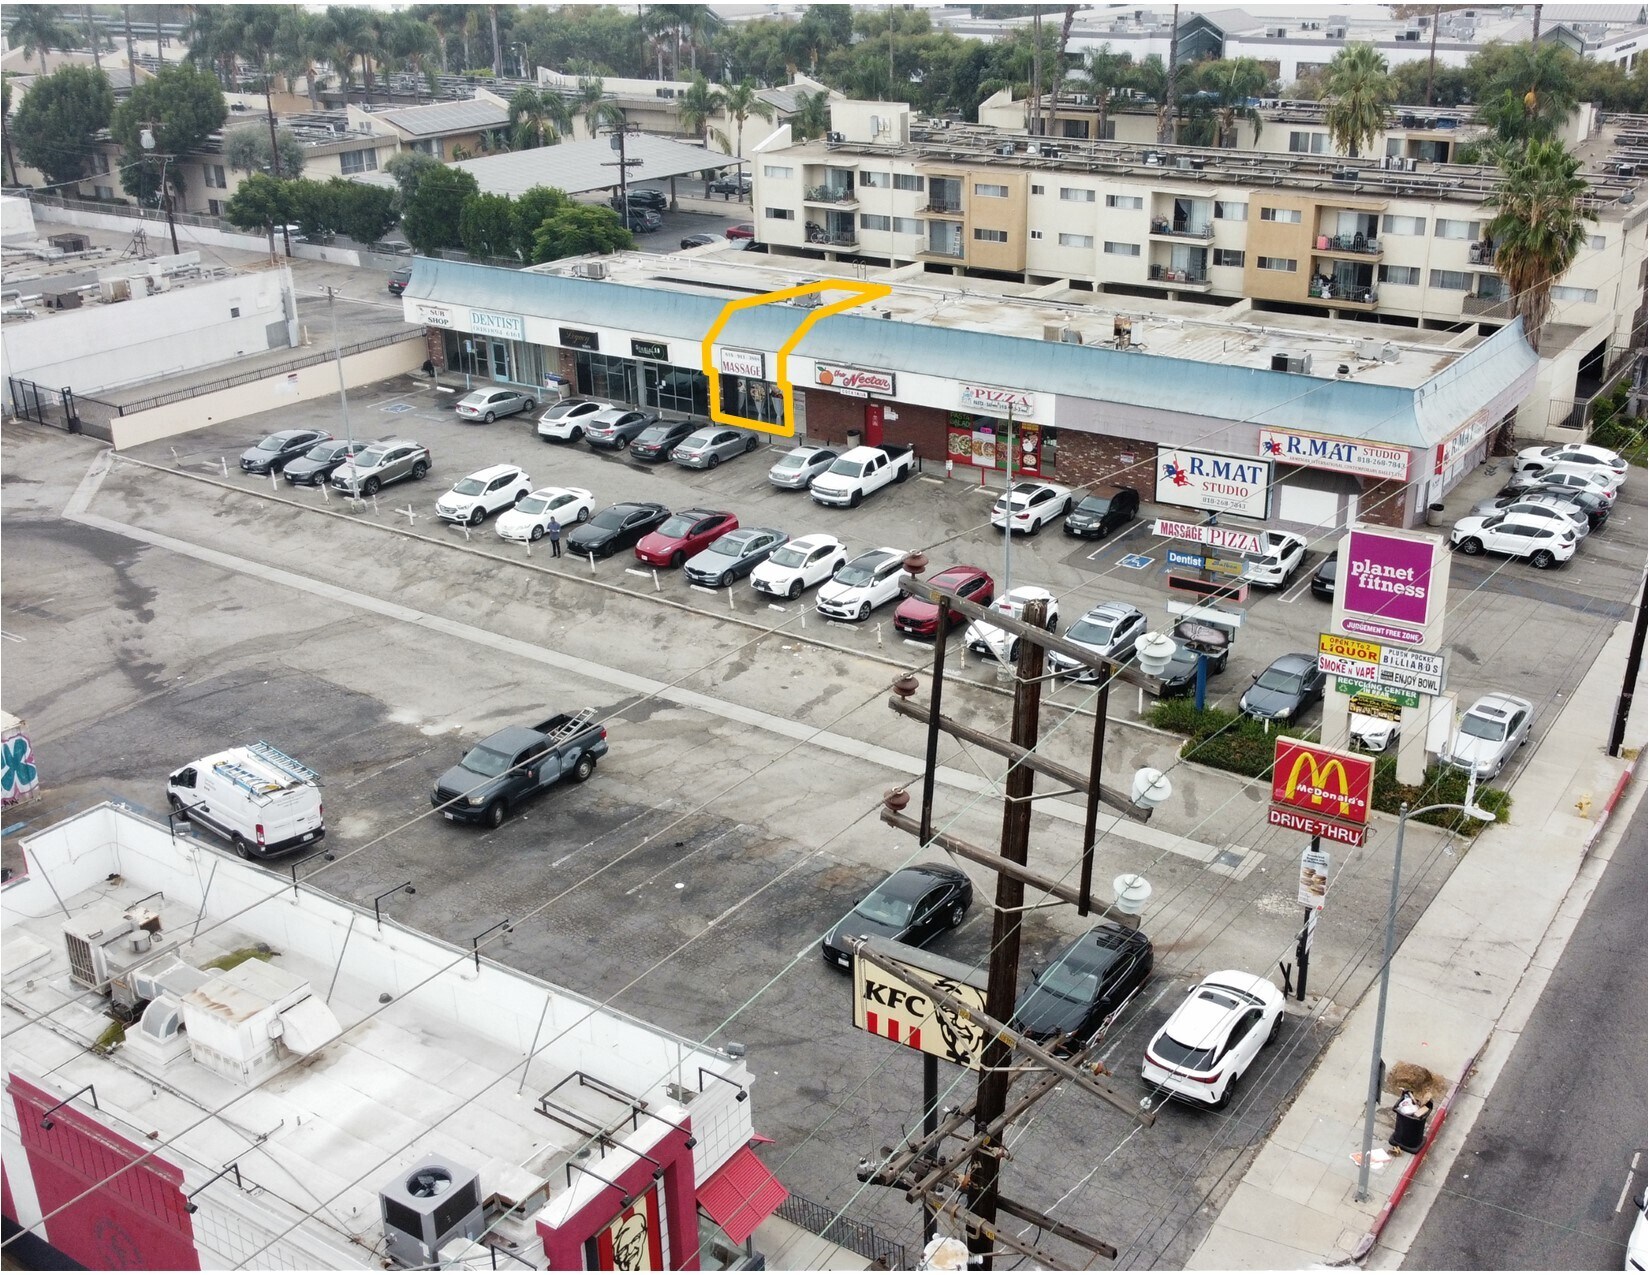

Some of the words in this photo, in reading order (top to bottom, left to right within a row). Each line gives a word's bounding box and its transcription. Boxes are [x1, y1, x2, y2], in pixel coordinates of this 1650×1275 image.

[427, 316, 449, 326] SHOP
[429, 309, 446, 317] SUB
[472, 312, 520, 331] DENTIST
[722, 361, 761, 377] MASSAGE
[842, 372, 891, 391] Nectar
[974, 388, 1032, 407] PIZZA
[1287, 435, 1358, 463] R.MAT
[1363, 448, 1401, 461] STUDIO
[1189, 456, 1263, 485] R.MAT
[1356, 456, 1406, 470] 818-268-7843
[1202, 481, 1249, 498] STUDIO
[1202, 497, 1246, 510] 818-268-7843
[1160, 521, 1203, 541] MASSAGE
[1210, 529, 1260, 553] PIZZA
[1169, 552, 1202, 567] Dentist
[1350, 558, 1414, 582] planet
[1358, 573, 1426, 599] fitness
[1346, 621, 1385, 635] JUDGEMENT
[1385, 629, 1402, 638] FREE
[1402, 631, 1420, 641] ZONE
[1329, 637, 1350, 646] OPEN
[1383, 655, 1439, 674] BILLIARDS
[1388, 648, 1409, 659] PLUSH
[1410, 653, 1435, 664] POCKET
[1319, 656, 1347, 674] SMOKE
[1355, 666, 1376, 680] VAPE
[1337, 676, 1383, 691] RECYCLING
[1384, 685, 1417, 699] CENTER
[1394, 672, 1417, 687] ENJOY
[1417, 677, 1438, 691] BOWL
[1371, 689, 1390, 698] REAR
[1296, 783, 1365, 807] McDonald's
[1270, 810, 1360, 844] DRIVE-THRU
[863, 979, 926, 1018] KFC
